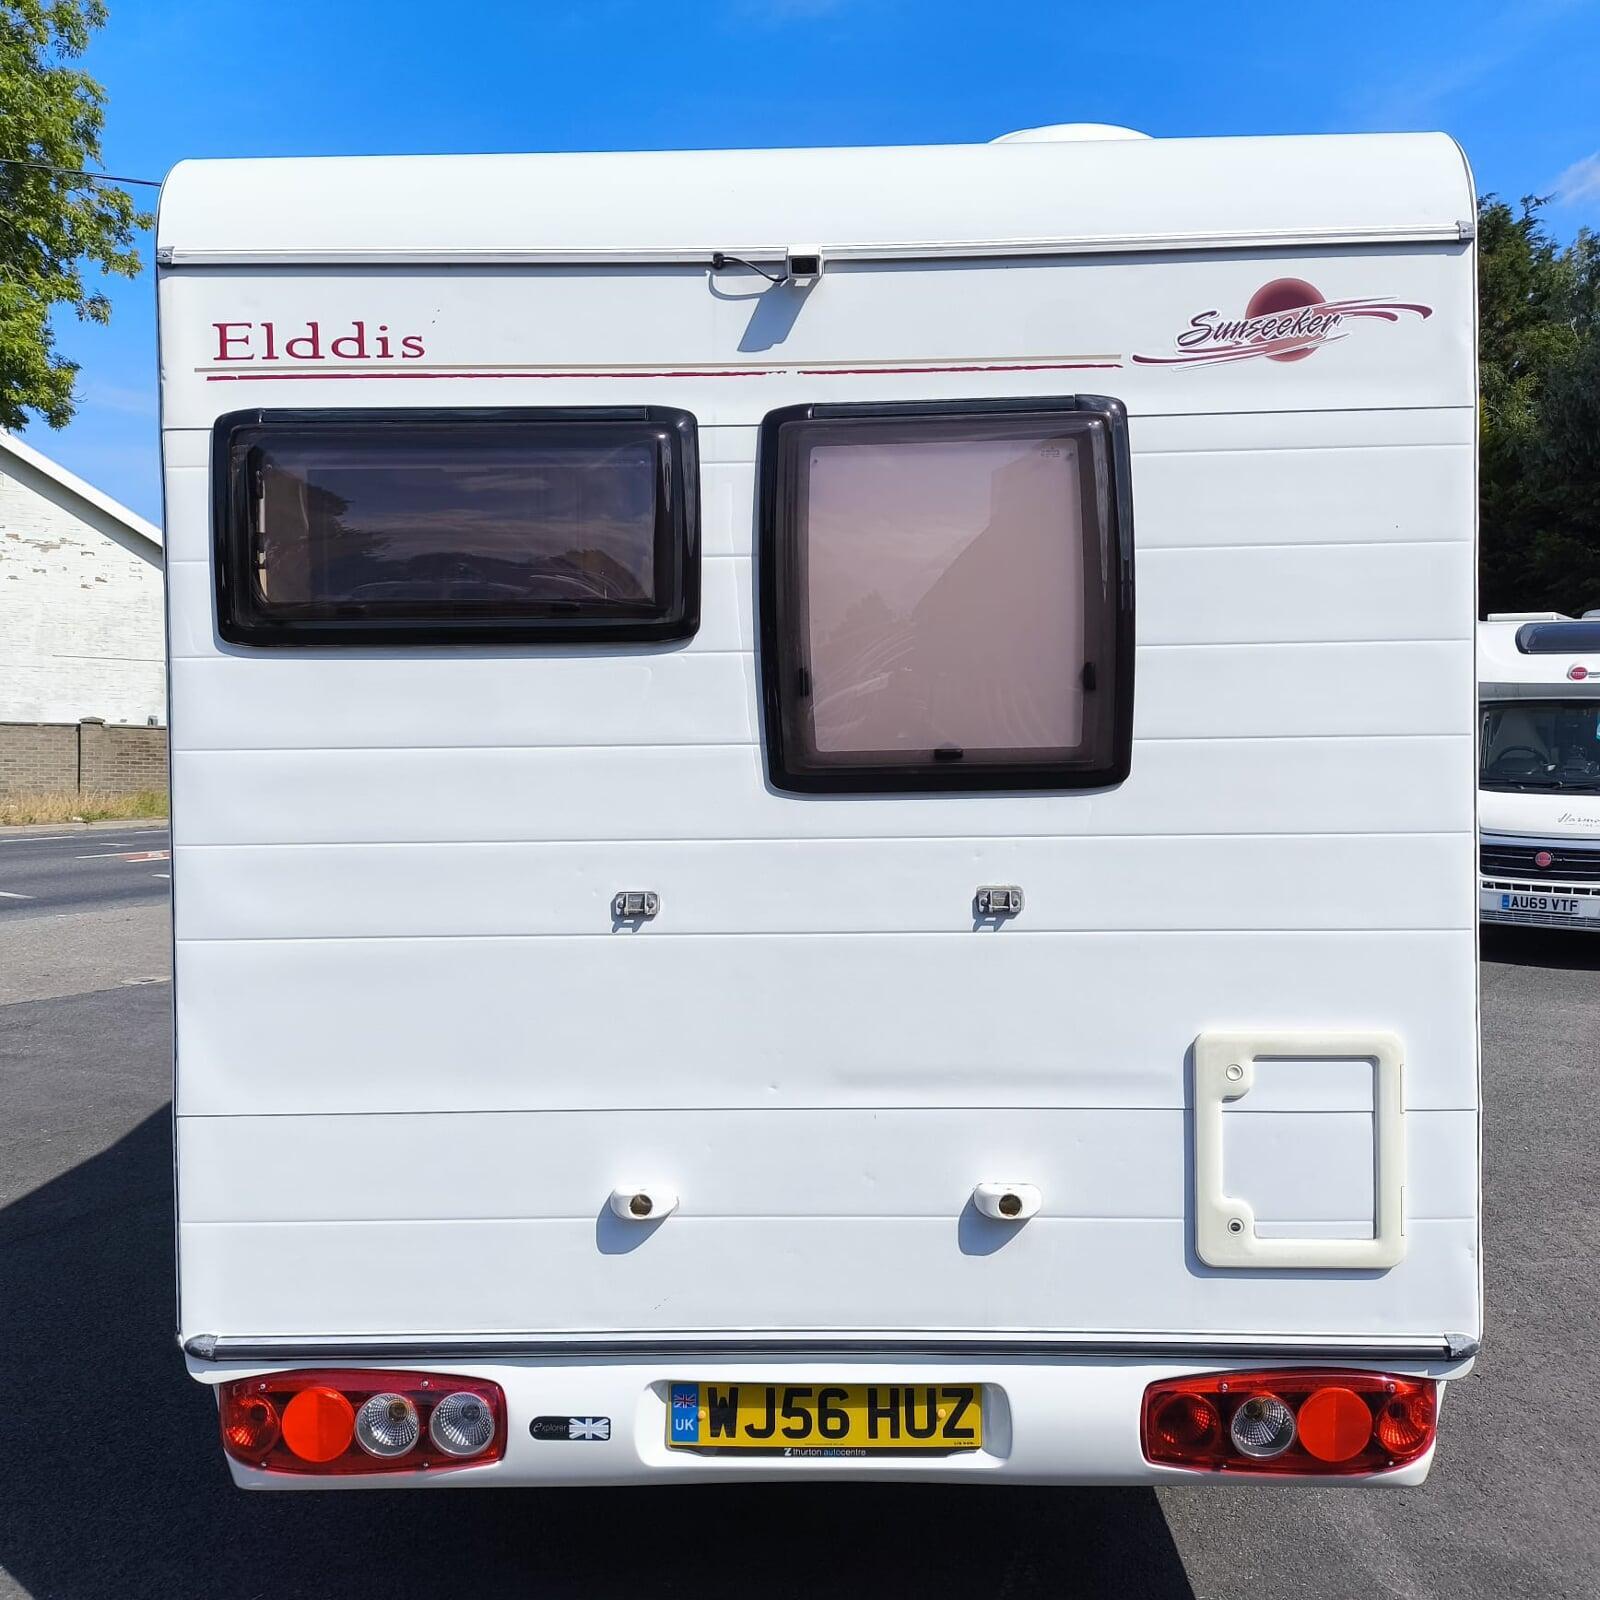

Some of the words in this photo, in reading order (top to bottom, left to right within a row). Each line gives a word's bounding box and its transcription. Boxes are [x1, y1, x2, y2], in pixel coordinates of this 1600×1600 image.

[211, 320, 426, 361] Elddis
[1177, 307, 1344, 347] Sunseeker
[1510, 895, 1548, 911] AU69
[1551, 898, 1580, 912] VTF
[674, 1417, 695, 1431] UK
[706, 1386, 851, 1440] WJ56
[867, 1386, 976, 1440] HUZ
